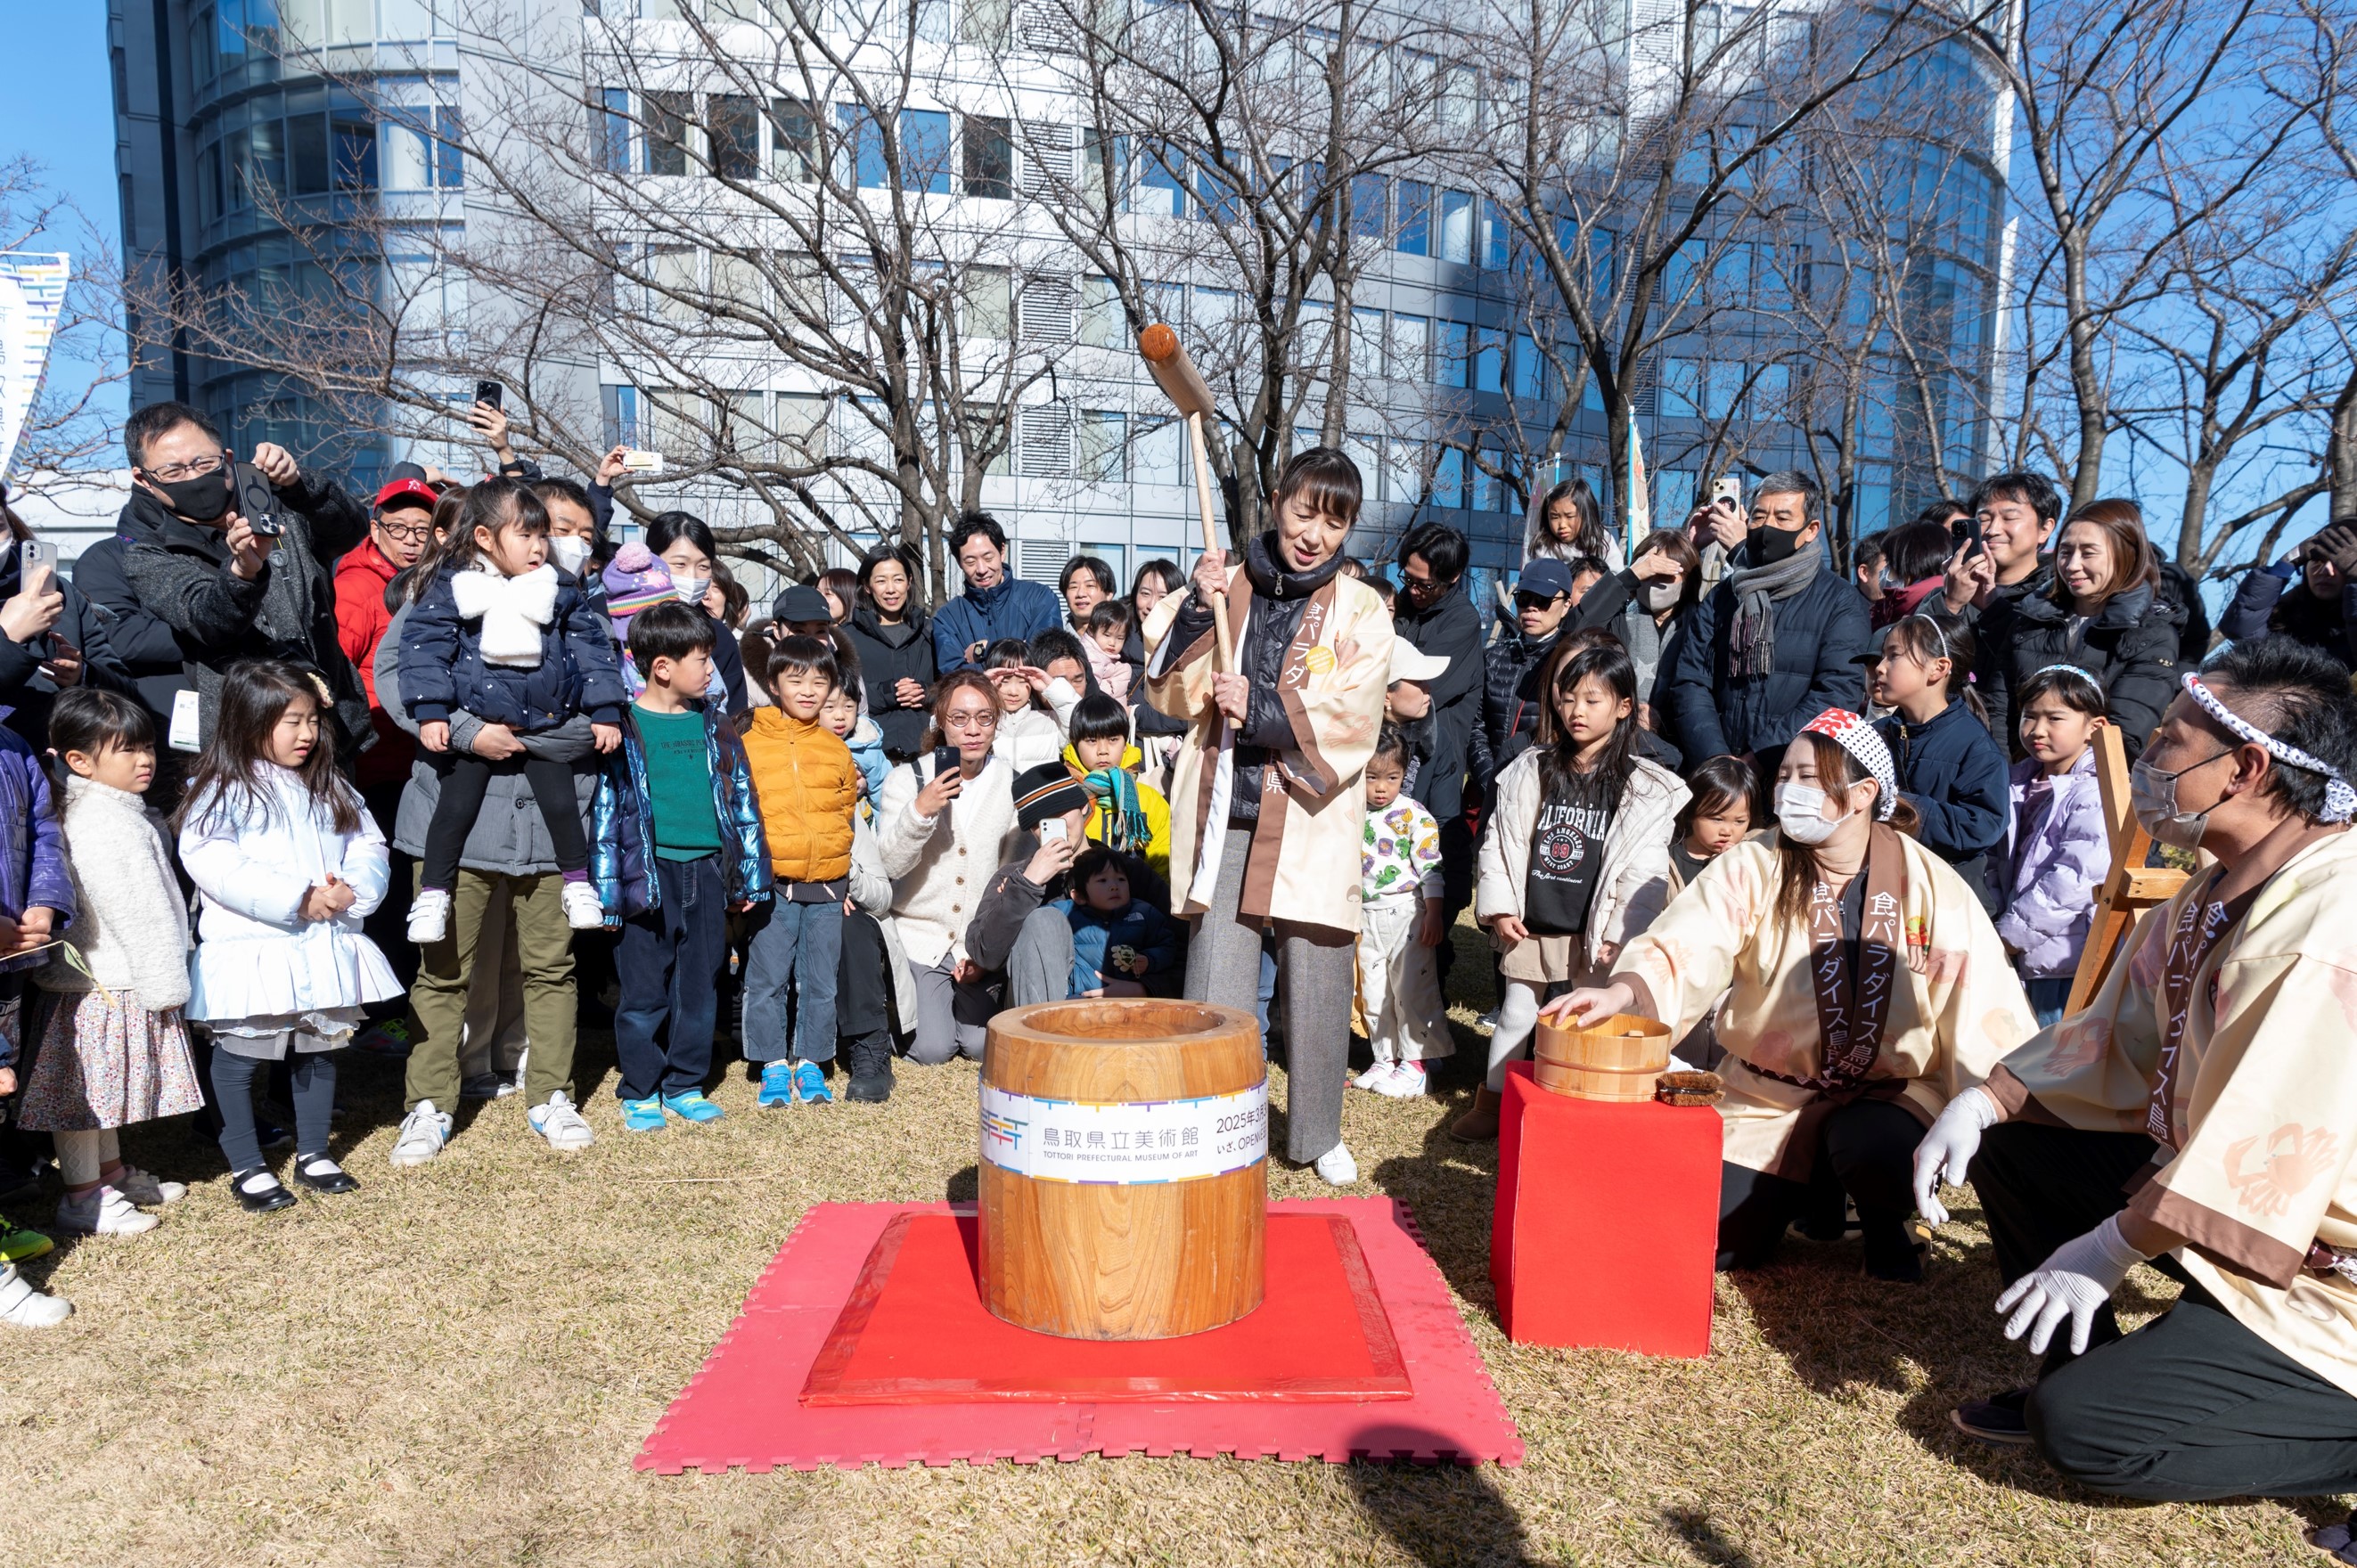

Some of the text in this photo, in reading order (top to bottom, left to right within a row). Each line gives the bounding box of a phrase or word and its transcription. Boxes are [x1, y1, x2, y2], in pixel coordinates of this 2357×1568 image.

[1285, 602, 1324, 690] 食パラダ
[1537, 805, 1607, 841] ALIFORNIA
[1543, 828, 1583, 849] LOS ANGELES
[1551, 843, 1570, 858] 89
[1543, 856, 1574, 870] WEST COAST
[1043, 1126, 1199, 1149] 鳥取県立美術館
[1043, 1150, 1074, 1161] TOTTORI
[1076, 1154, 1133, 1162] PREFECTURAL
[1134, 1153, 1170, 1162] MUSEUM
[1184, 1150, 1199, 1158] ART
